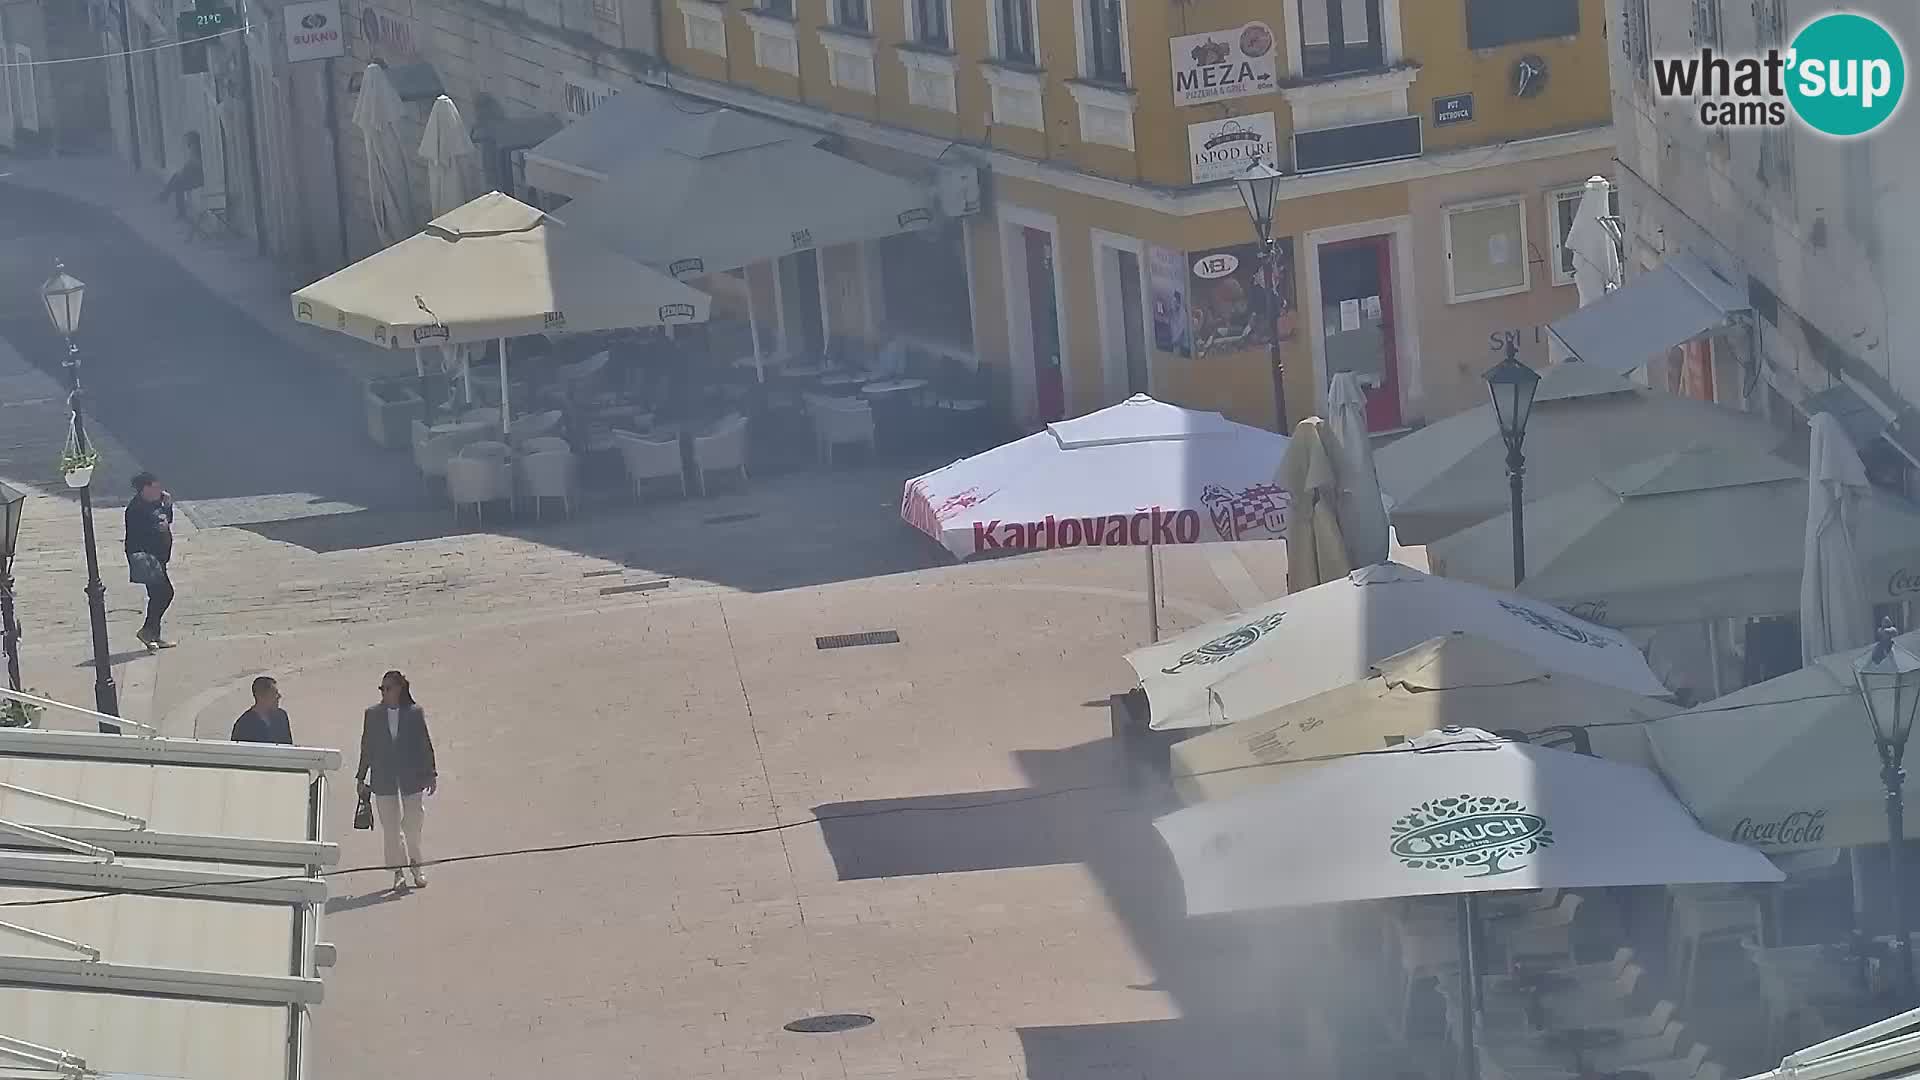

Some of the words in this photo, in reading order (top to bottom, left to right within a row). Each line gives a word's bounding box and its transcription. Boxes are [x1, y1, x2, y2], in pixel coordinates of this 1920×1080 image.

[197, 13, 222, 25] 21°C
[1176, 61, 1255, 92] MEZA
[1195, 147, 1240, 165] ISPOD
[973, 505, 1200, 553] Karlovačko
[1429, 818, 1529, 849] RAUCH
[1730, 808, 1828, 845] Coca-Cola
